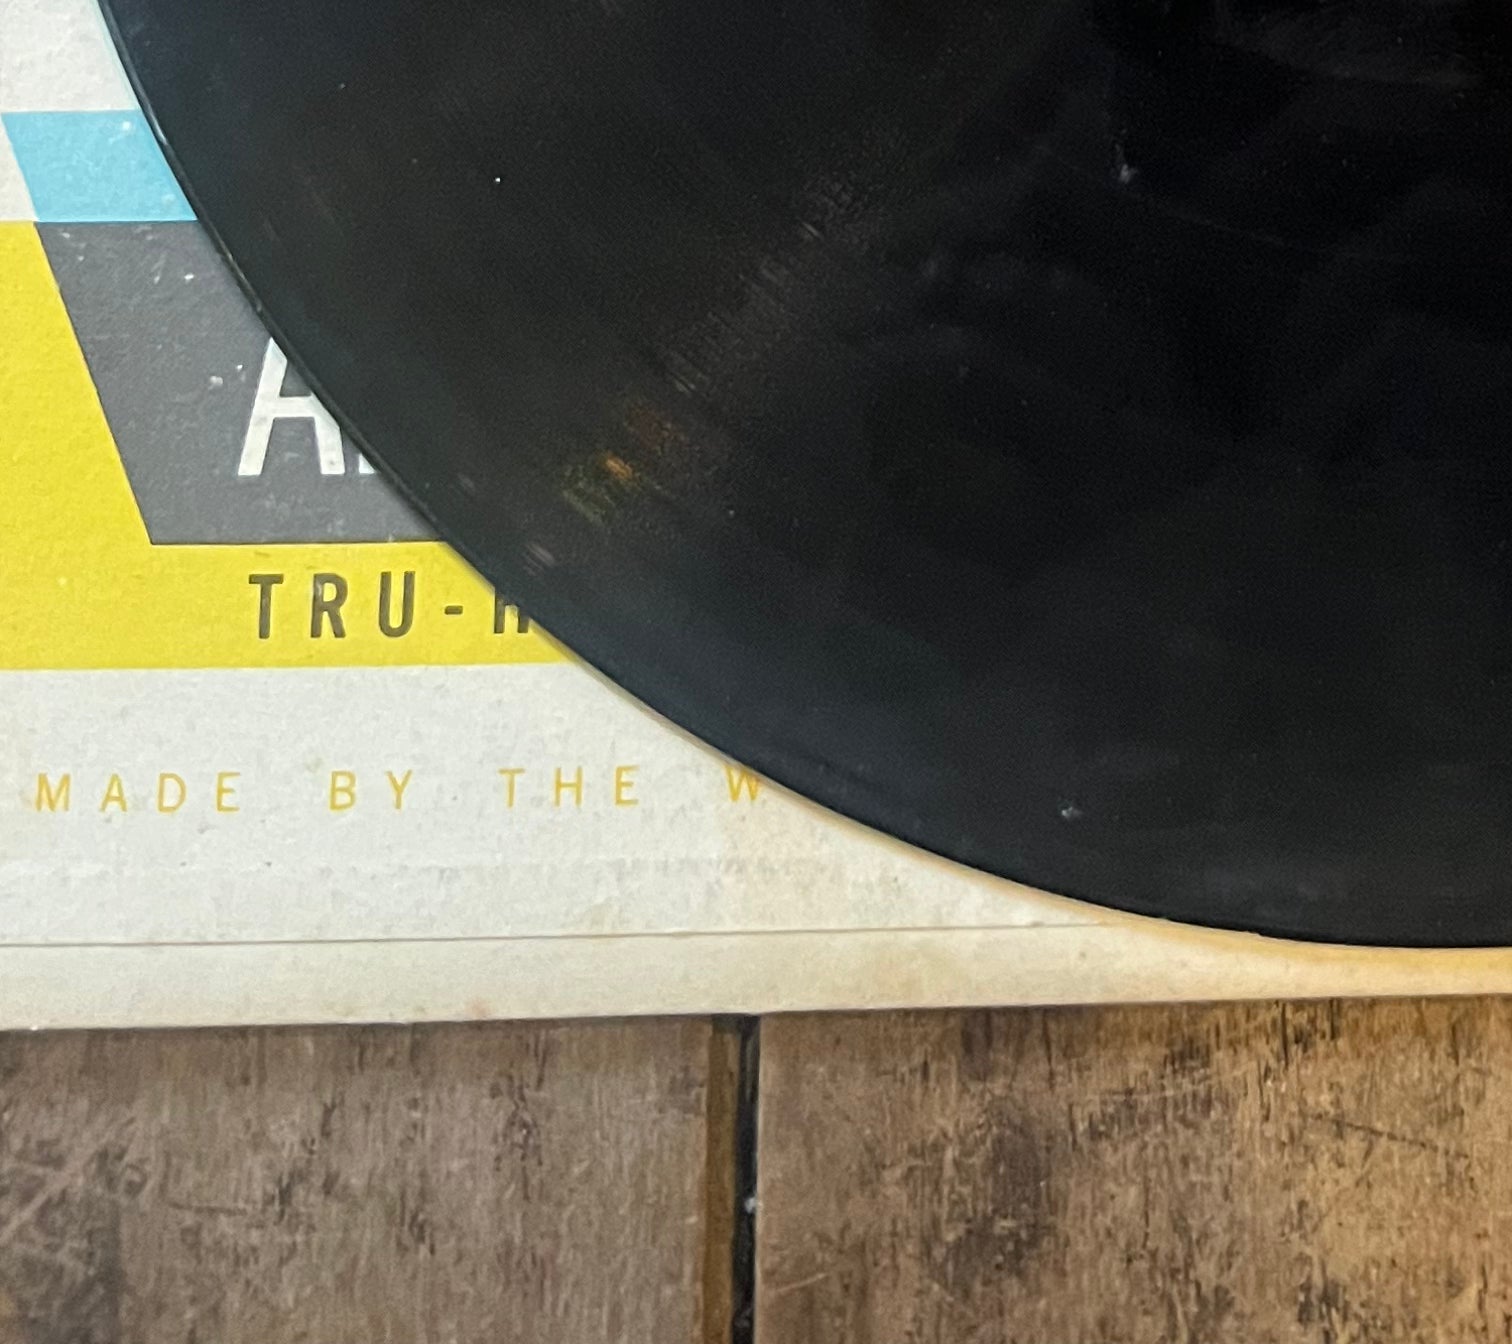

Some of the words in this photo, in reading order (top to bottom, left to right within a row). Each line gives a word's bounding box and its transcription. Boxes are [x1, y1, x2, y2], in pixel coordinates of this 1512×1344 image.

[34, 771, 241, 814] MADE
[328, 769, 414, 811] BY
[498, 764, 640, 809] THE
